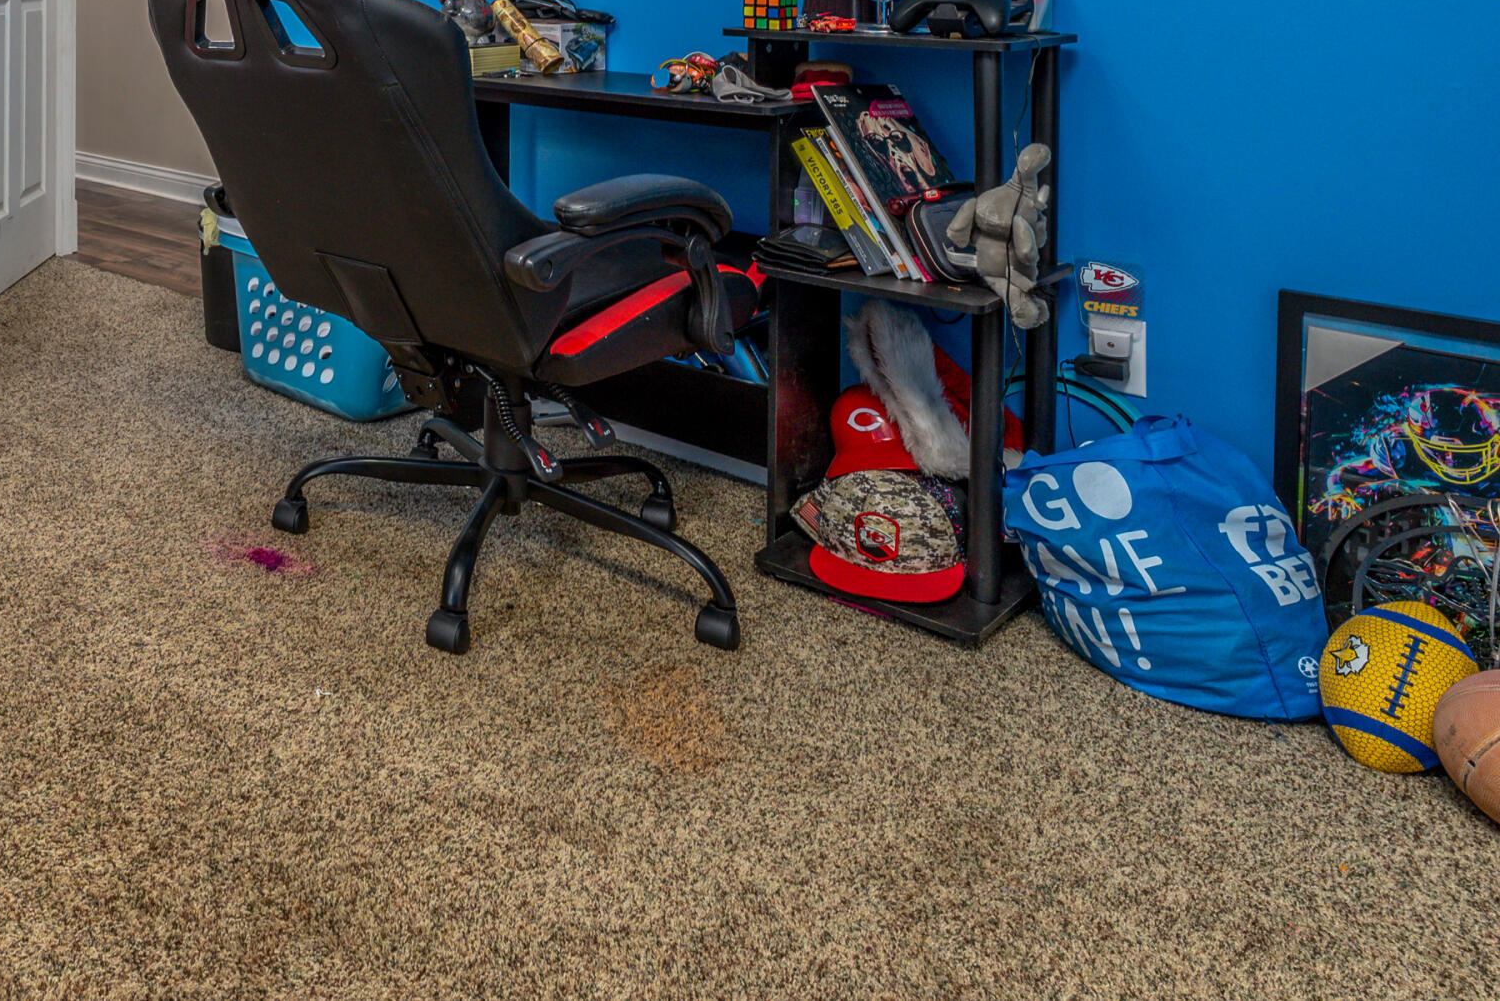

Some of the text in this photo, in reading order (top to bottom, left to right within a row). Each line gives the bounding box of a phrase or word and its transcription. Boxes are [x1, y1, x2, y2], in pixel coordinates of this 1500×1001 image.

[806, 156, 833, 201] VICTORY
[831, 196, 843, 215] 365
[1083, 300, 1139, 317] CHIEFS
